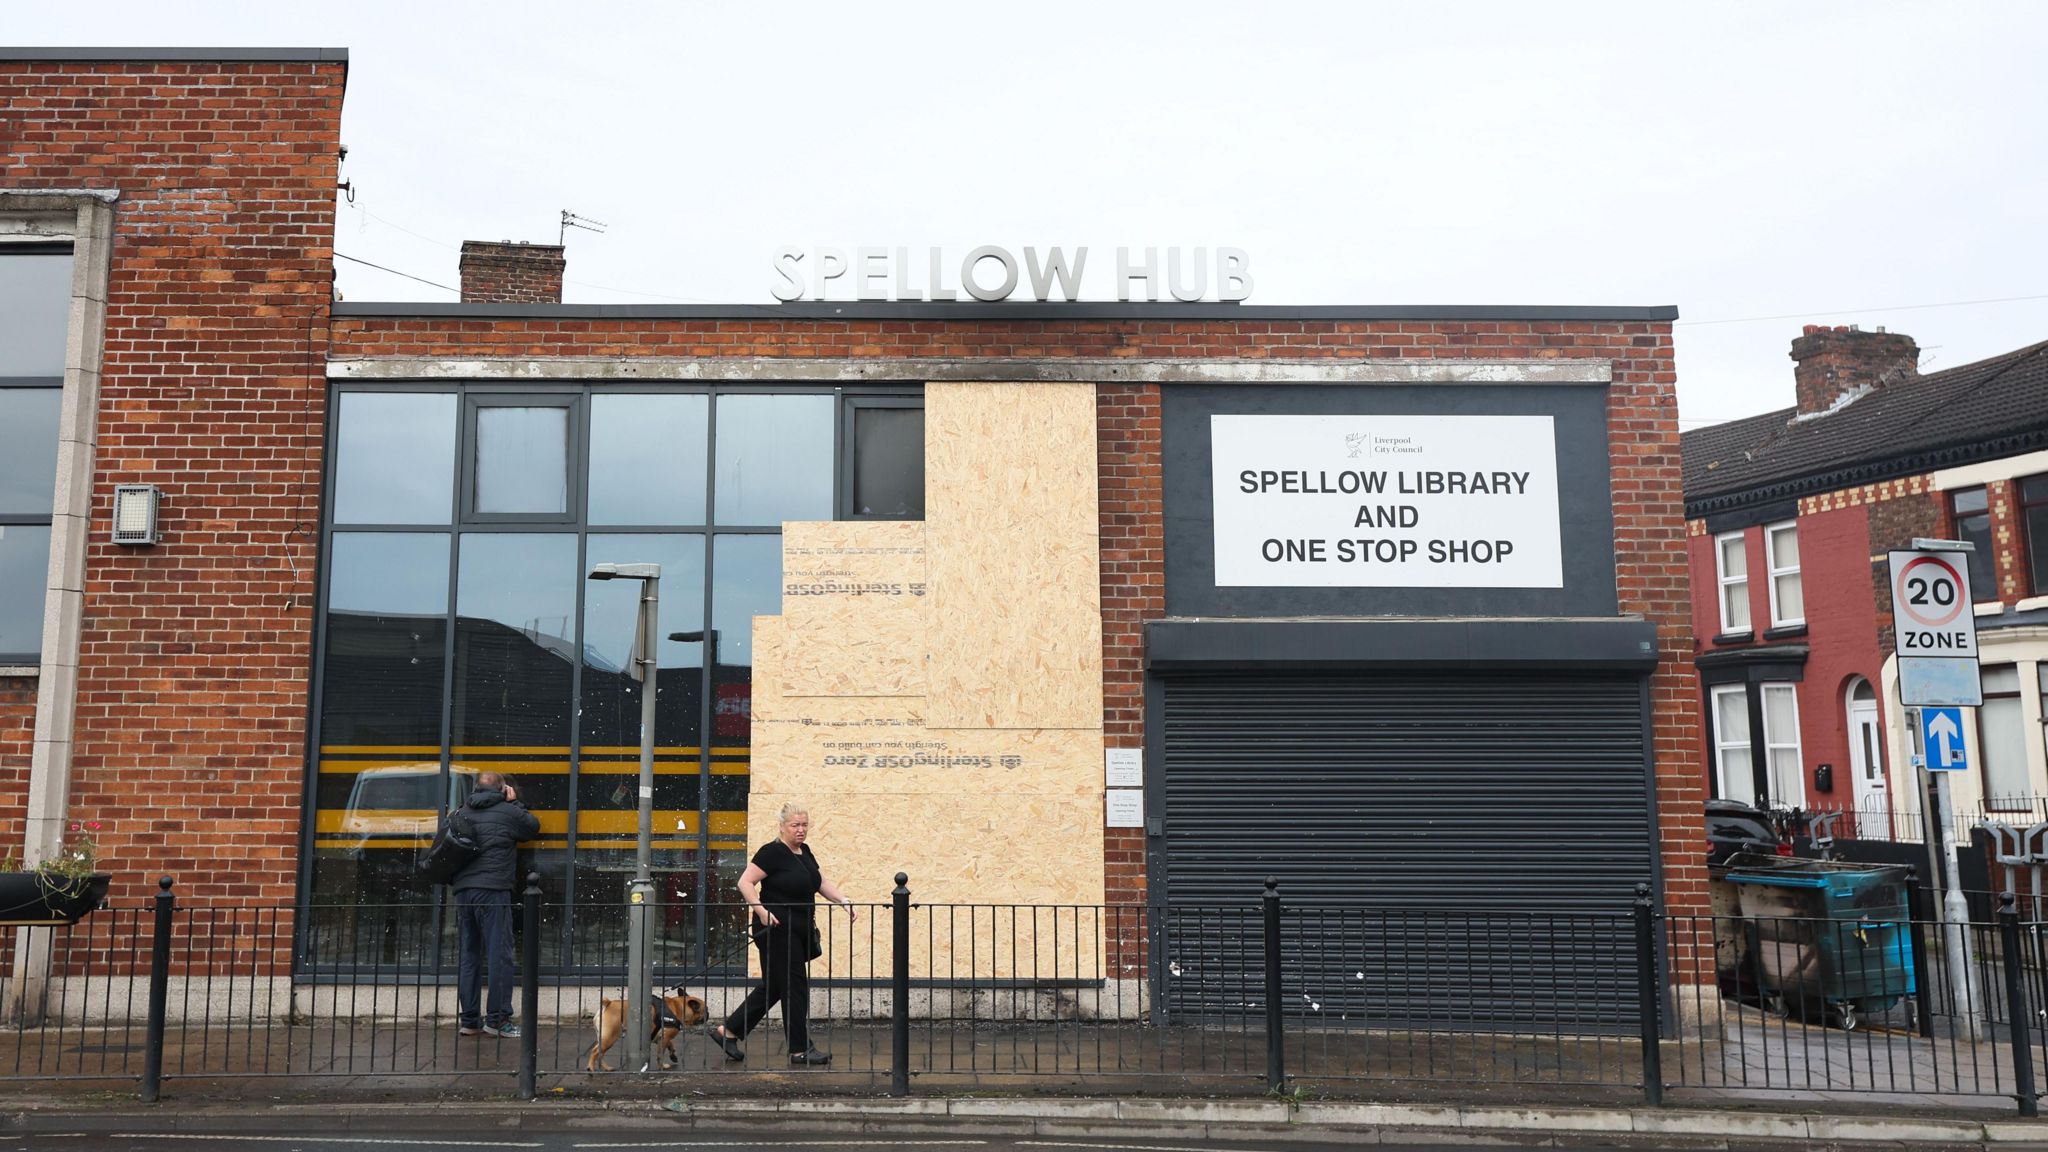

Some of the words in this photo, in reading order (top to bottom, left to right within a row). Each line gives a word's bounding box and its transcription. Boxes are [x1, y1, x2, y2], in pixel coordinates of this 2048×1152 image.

[770, 245, 1088, 302] SPELLOW
[1116, 246, 1254, 302] HUB
[1375, 437, 1411, 446] Liverpool
[1375, 446, 1391, 455] City
[1240, 470, 1387, 494] SPELLOW
[1399, 471, 1530, 494] LIBRARY
[1354, 505, 1418, 528] AND
[1262, 539, 1326, 562] ONE
[1337, 539, 1417, 563] STOP
[1428, 540, 1513, 563] SHOP
[1908, 578, 1955, 605] 20
[1905, 631, 1968, 649] ZONE
[838, 742, 862, 751] build
[905, 742, 948, 751] Strength
